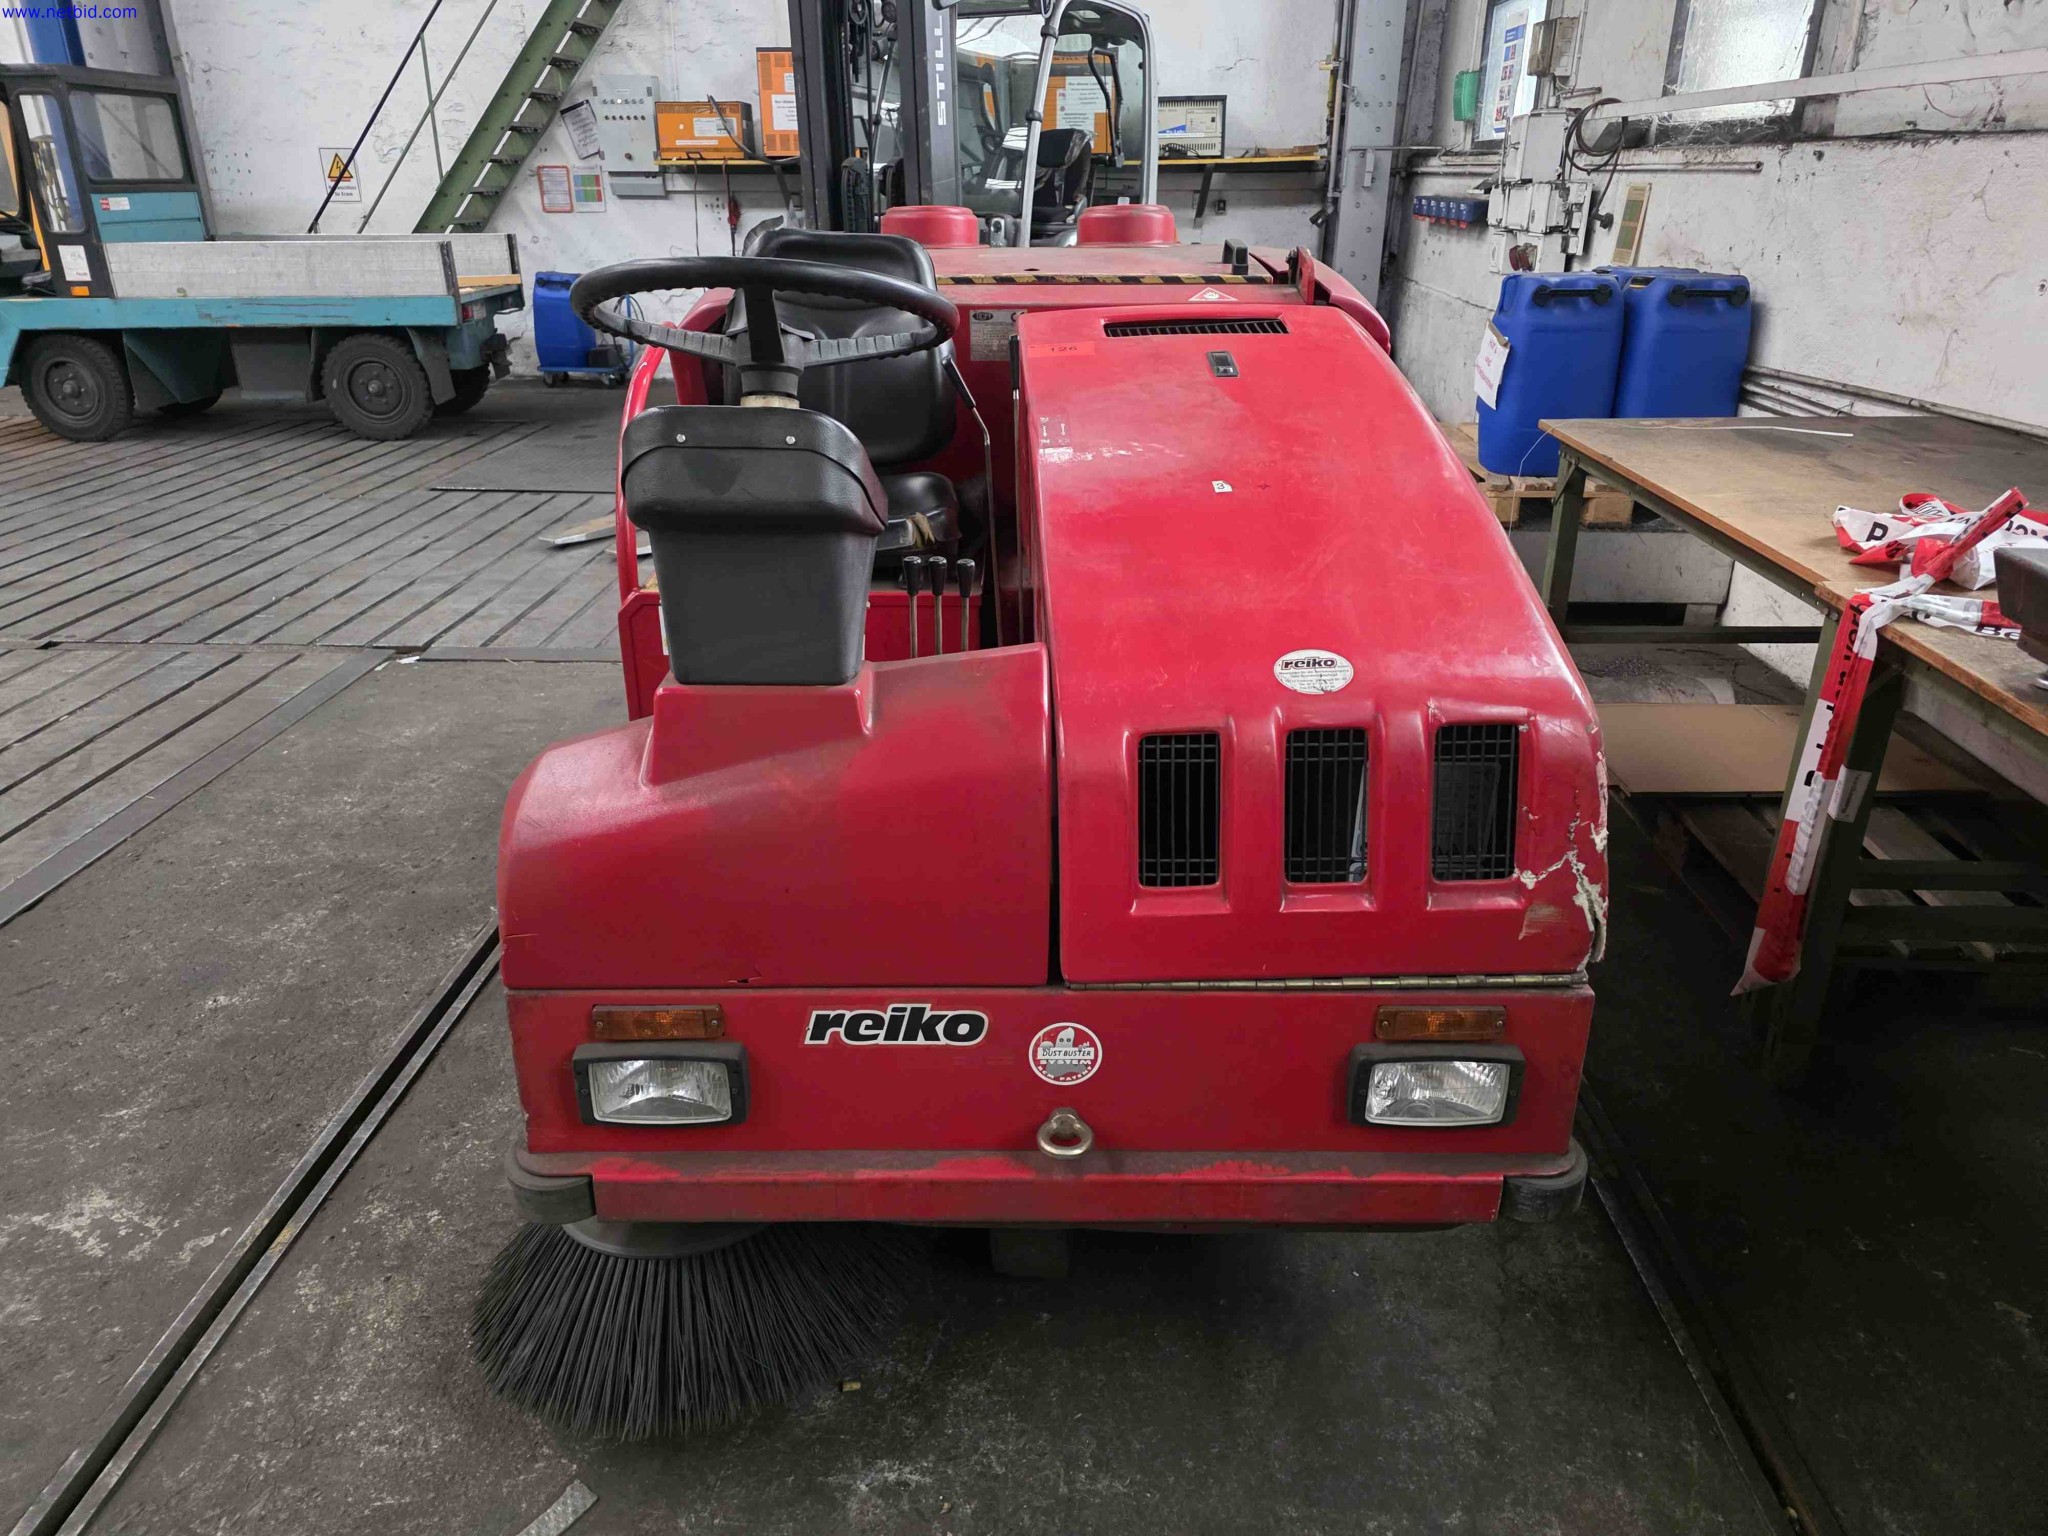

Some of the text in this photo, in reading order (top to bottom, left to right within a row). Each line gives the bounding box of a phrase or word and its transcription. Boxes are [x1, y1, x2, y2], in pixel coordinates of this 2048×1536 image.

[934, 15, 946, 125] STILL
[1216, 482, 1225, 490] 3
[1283, 658, 1336, 669] reiko
[807, 1005, 987, 1044] reiko
